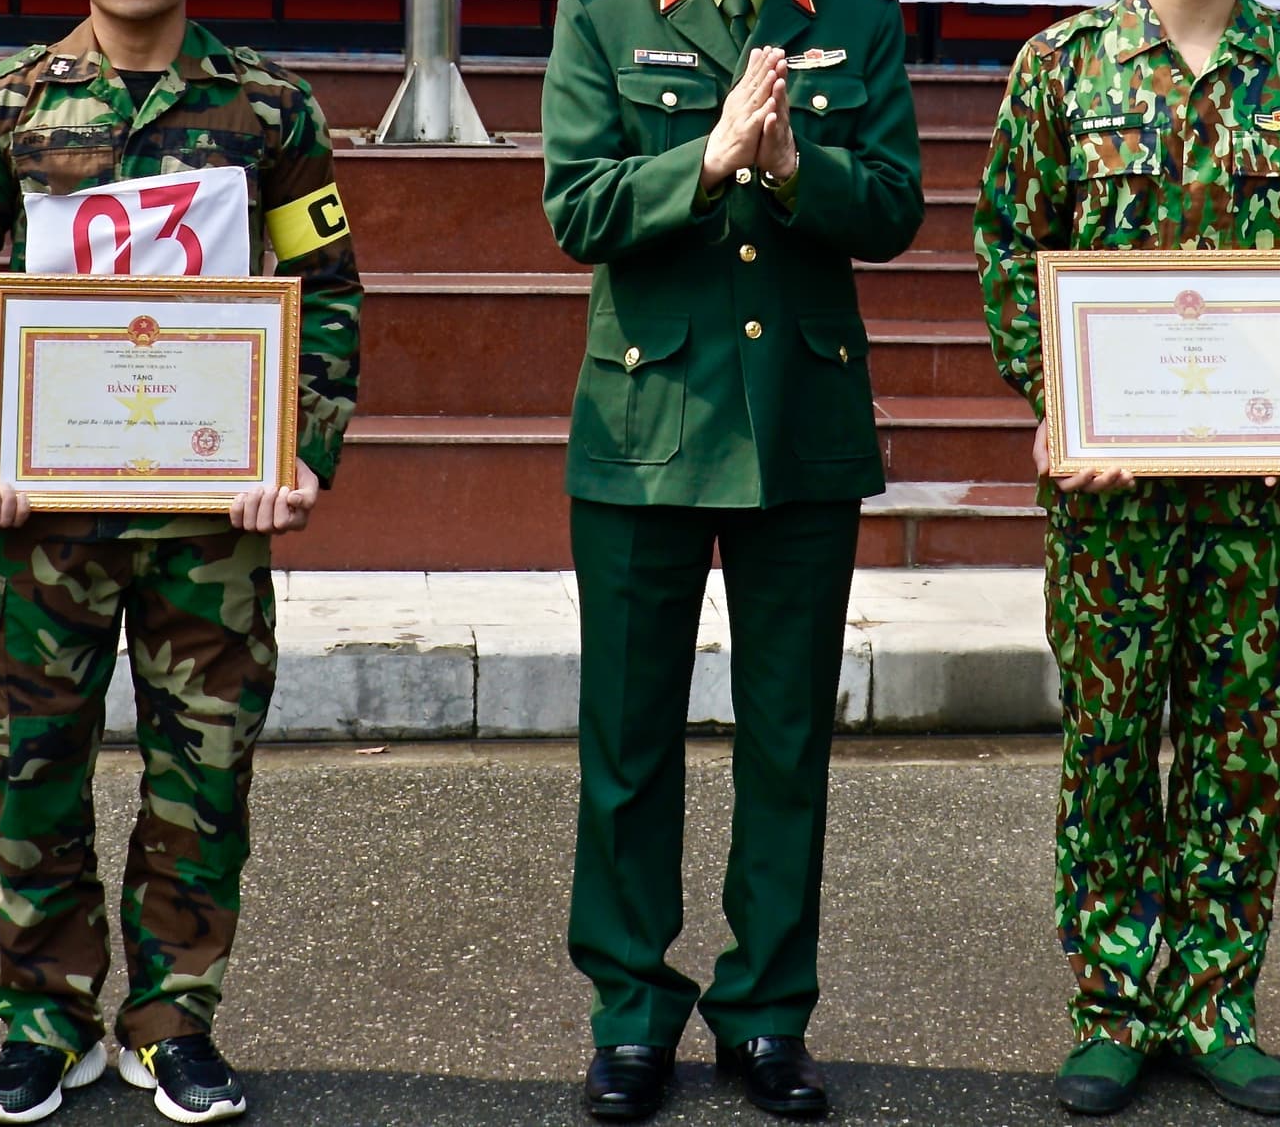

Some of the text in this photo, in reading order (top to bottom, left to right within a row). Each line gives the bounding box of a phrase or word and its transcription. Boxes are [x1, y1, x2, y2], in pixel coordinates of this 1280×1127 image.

[73, 181, 203, 276] 03
[308, 193, 345, 238] C
[144, 384, 177, 393] KHEN
